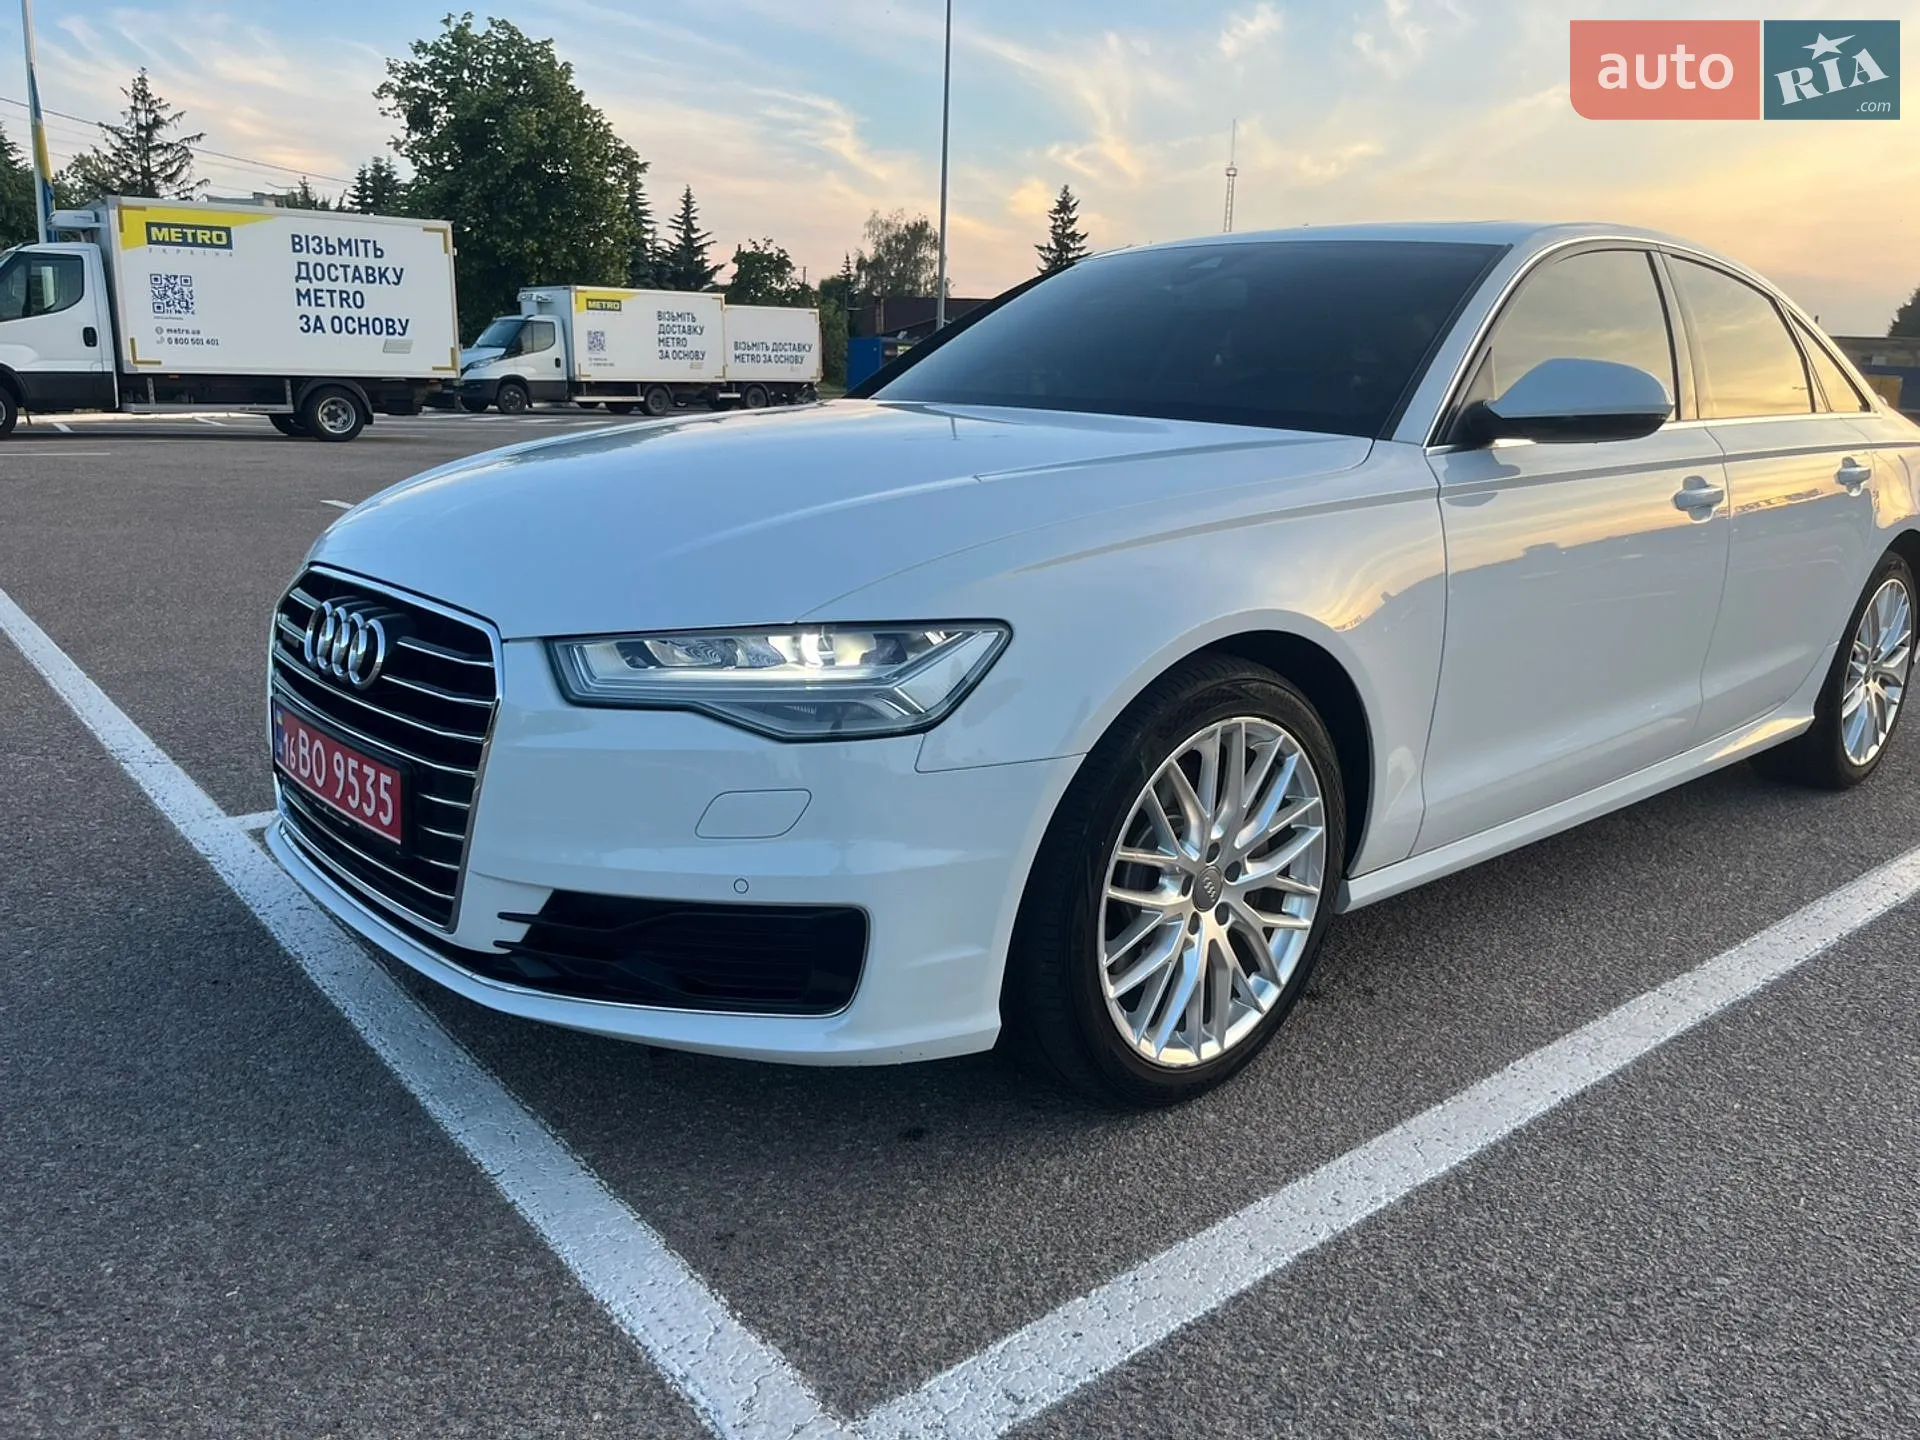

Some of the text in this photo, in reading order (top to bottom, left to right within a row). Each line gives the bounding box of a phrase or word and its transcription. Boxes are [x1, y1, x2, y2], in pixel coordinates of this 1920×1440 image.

[150, 226, 228, 246] METRO
[291, 234, 385, 259] ВІЗЬМІТЬ
[295, 261, 405, 286] ДОСТАВКУ
[295, 288, 365, 309] METRO
[587, 301, 620, 311] METRO
[657, 311, 697, 323] ВІЗЬМІТЬ
[299, 314, 410, 337] ЗА ОСНОВУ
[657, 324, 705, 336] ДОСТАВКУ
[657, 337, 688, 348] METRO
[734, 341, 813, 353] ВІЗЬМІТЬ ДОСТАВКУ
[659, 349, 706, 361] ЗА ОСНОВУ
[734, 353, 805, 365] METRO ЗА ОСНОВУ
[333, 751, 393, 826] 9535
